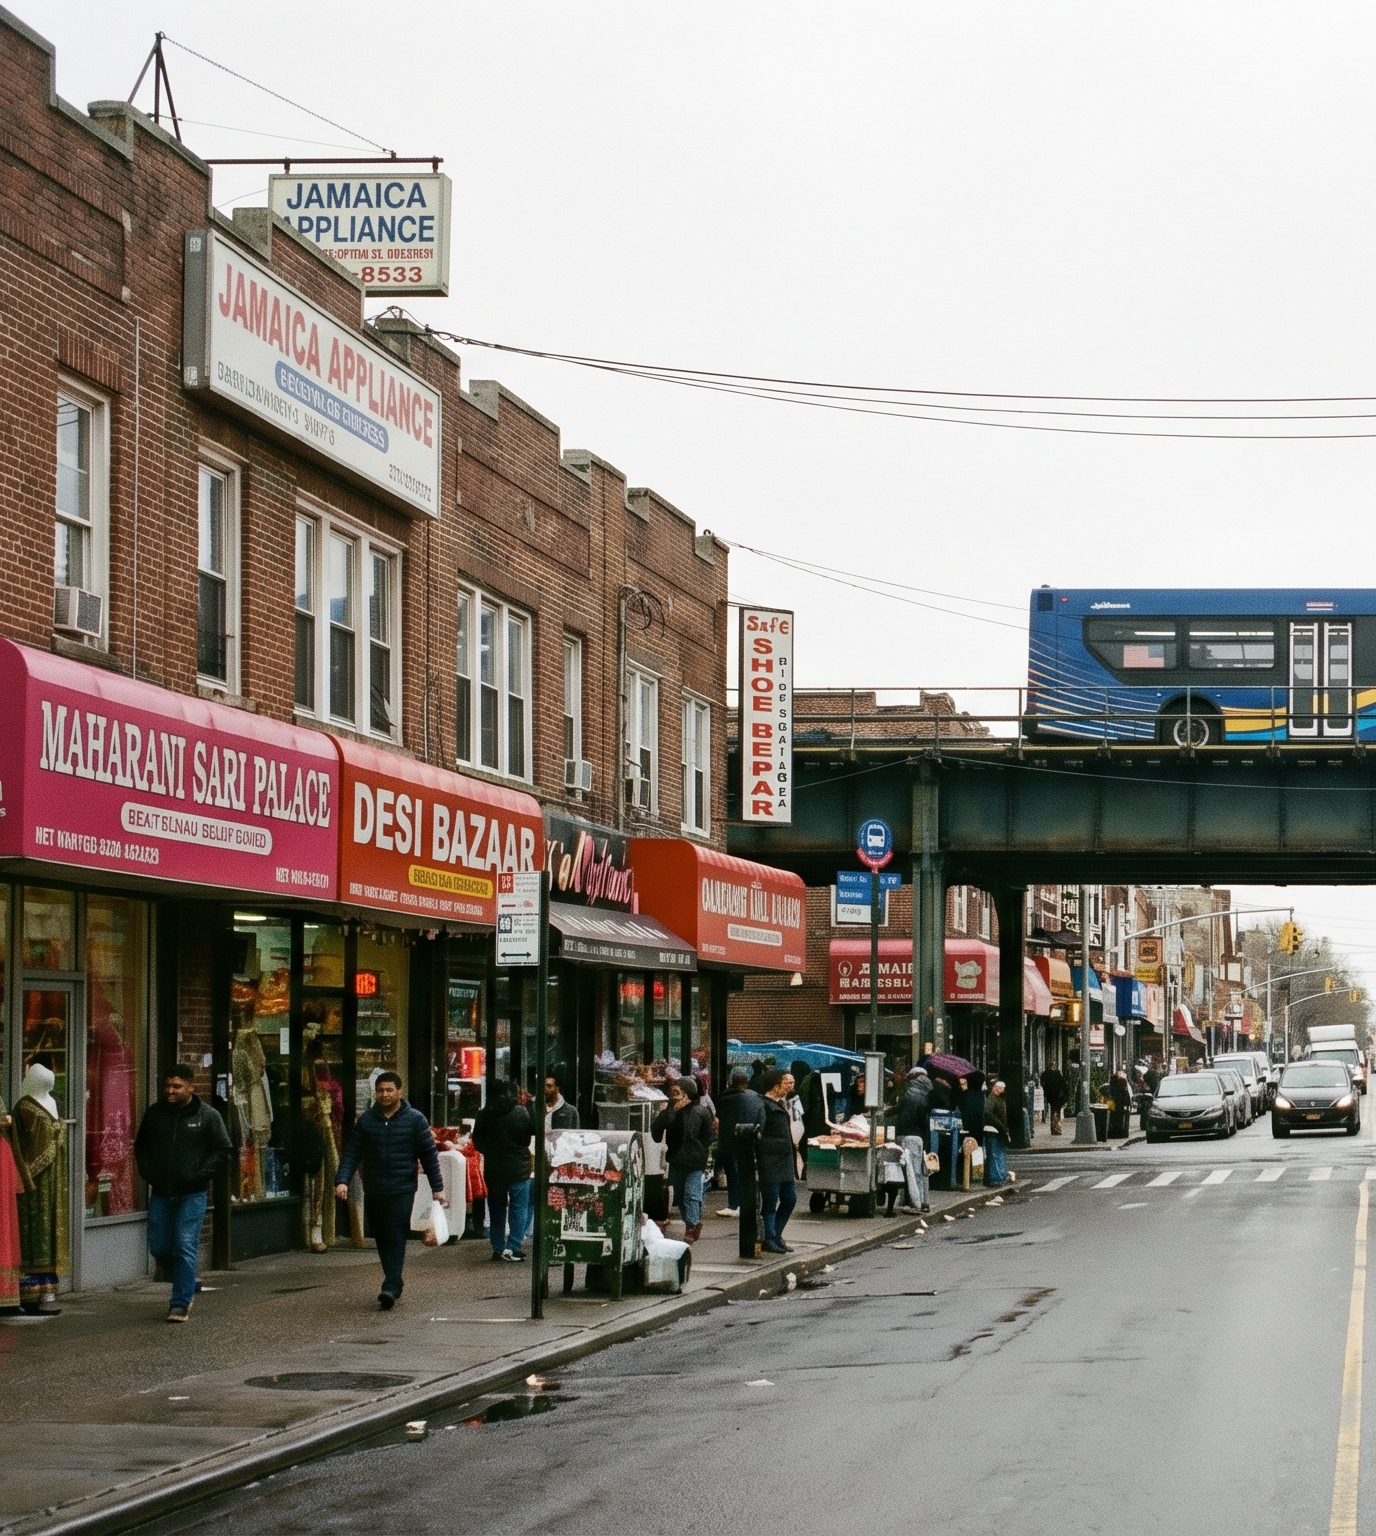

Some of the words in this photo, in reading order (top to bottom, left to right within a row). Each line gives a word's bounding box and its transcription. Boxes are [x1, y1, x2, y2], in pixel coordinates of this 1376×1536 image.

[283, 215, 435, 243] PPLIANCE
[286, 182, 427, 210] JAMAICA
[218, 263, 321, 378] JAMAICA
[327, 336, 433, 449] APPLIANCE
[750, 637, 774, 713] SHOE
[39, 700, 186, 801] MAHARANI
[192, 740, 248, 812] SARI
[252, 755, 332, 829] PALACE
[353, 781, 423, 857] DESI
[432, 803, 536, 873] BAZAAR
